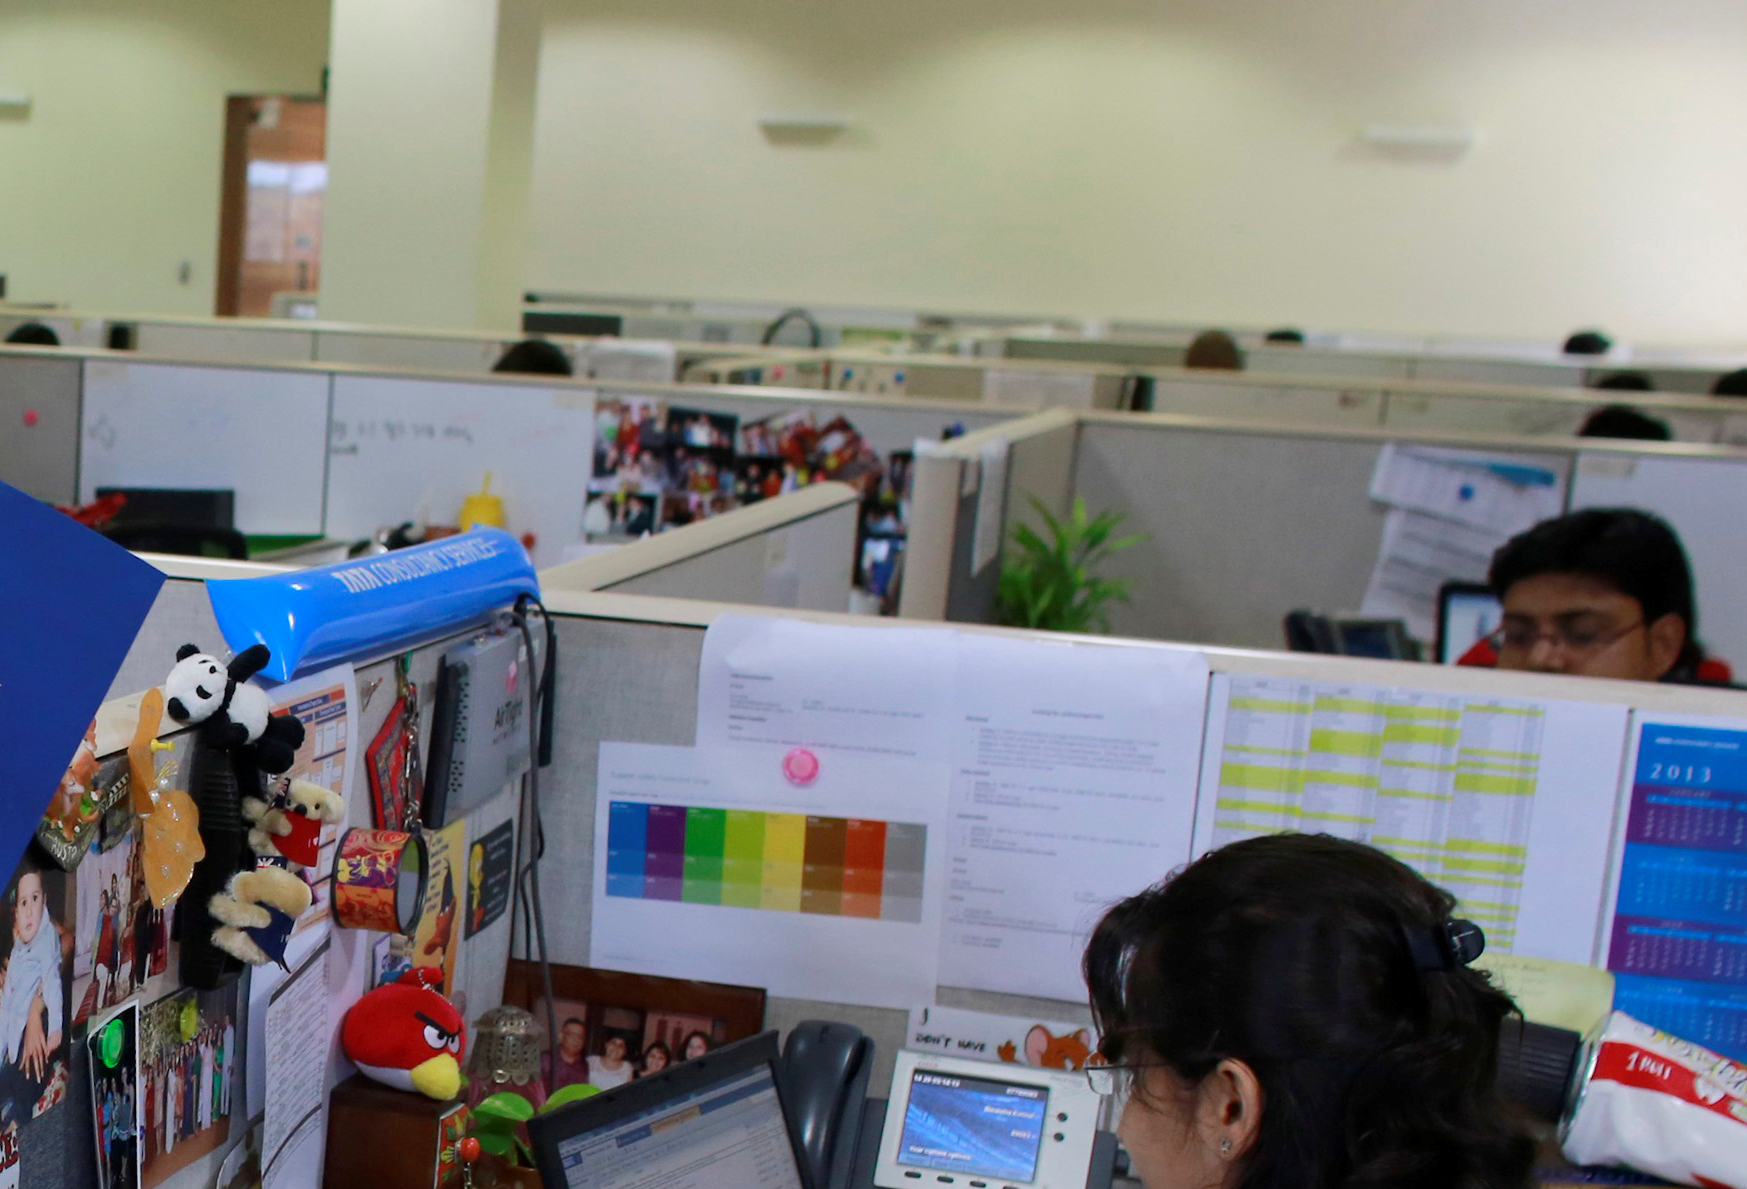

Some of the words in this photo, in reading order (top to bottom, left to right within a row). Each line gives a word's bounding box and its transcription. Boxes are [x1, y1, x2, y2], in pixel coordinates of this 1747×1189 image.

[331, 567, 384, 594] TATA
[1649, 762, 1711, 784] 2013
[915, 1032, 952, 1048] DON'T
[958, 1040, 988, 1052] HAVE
